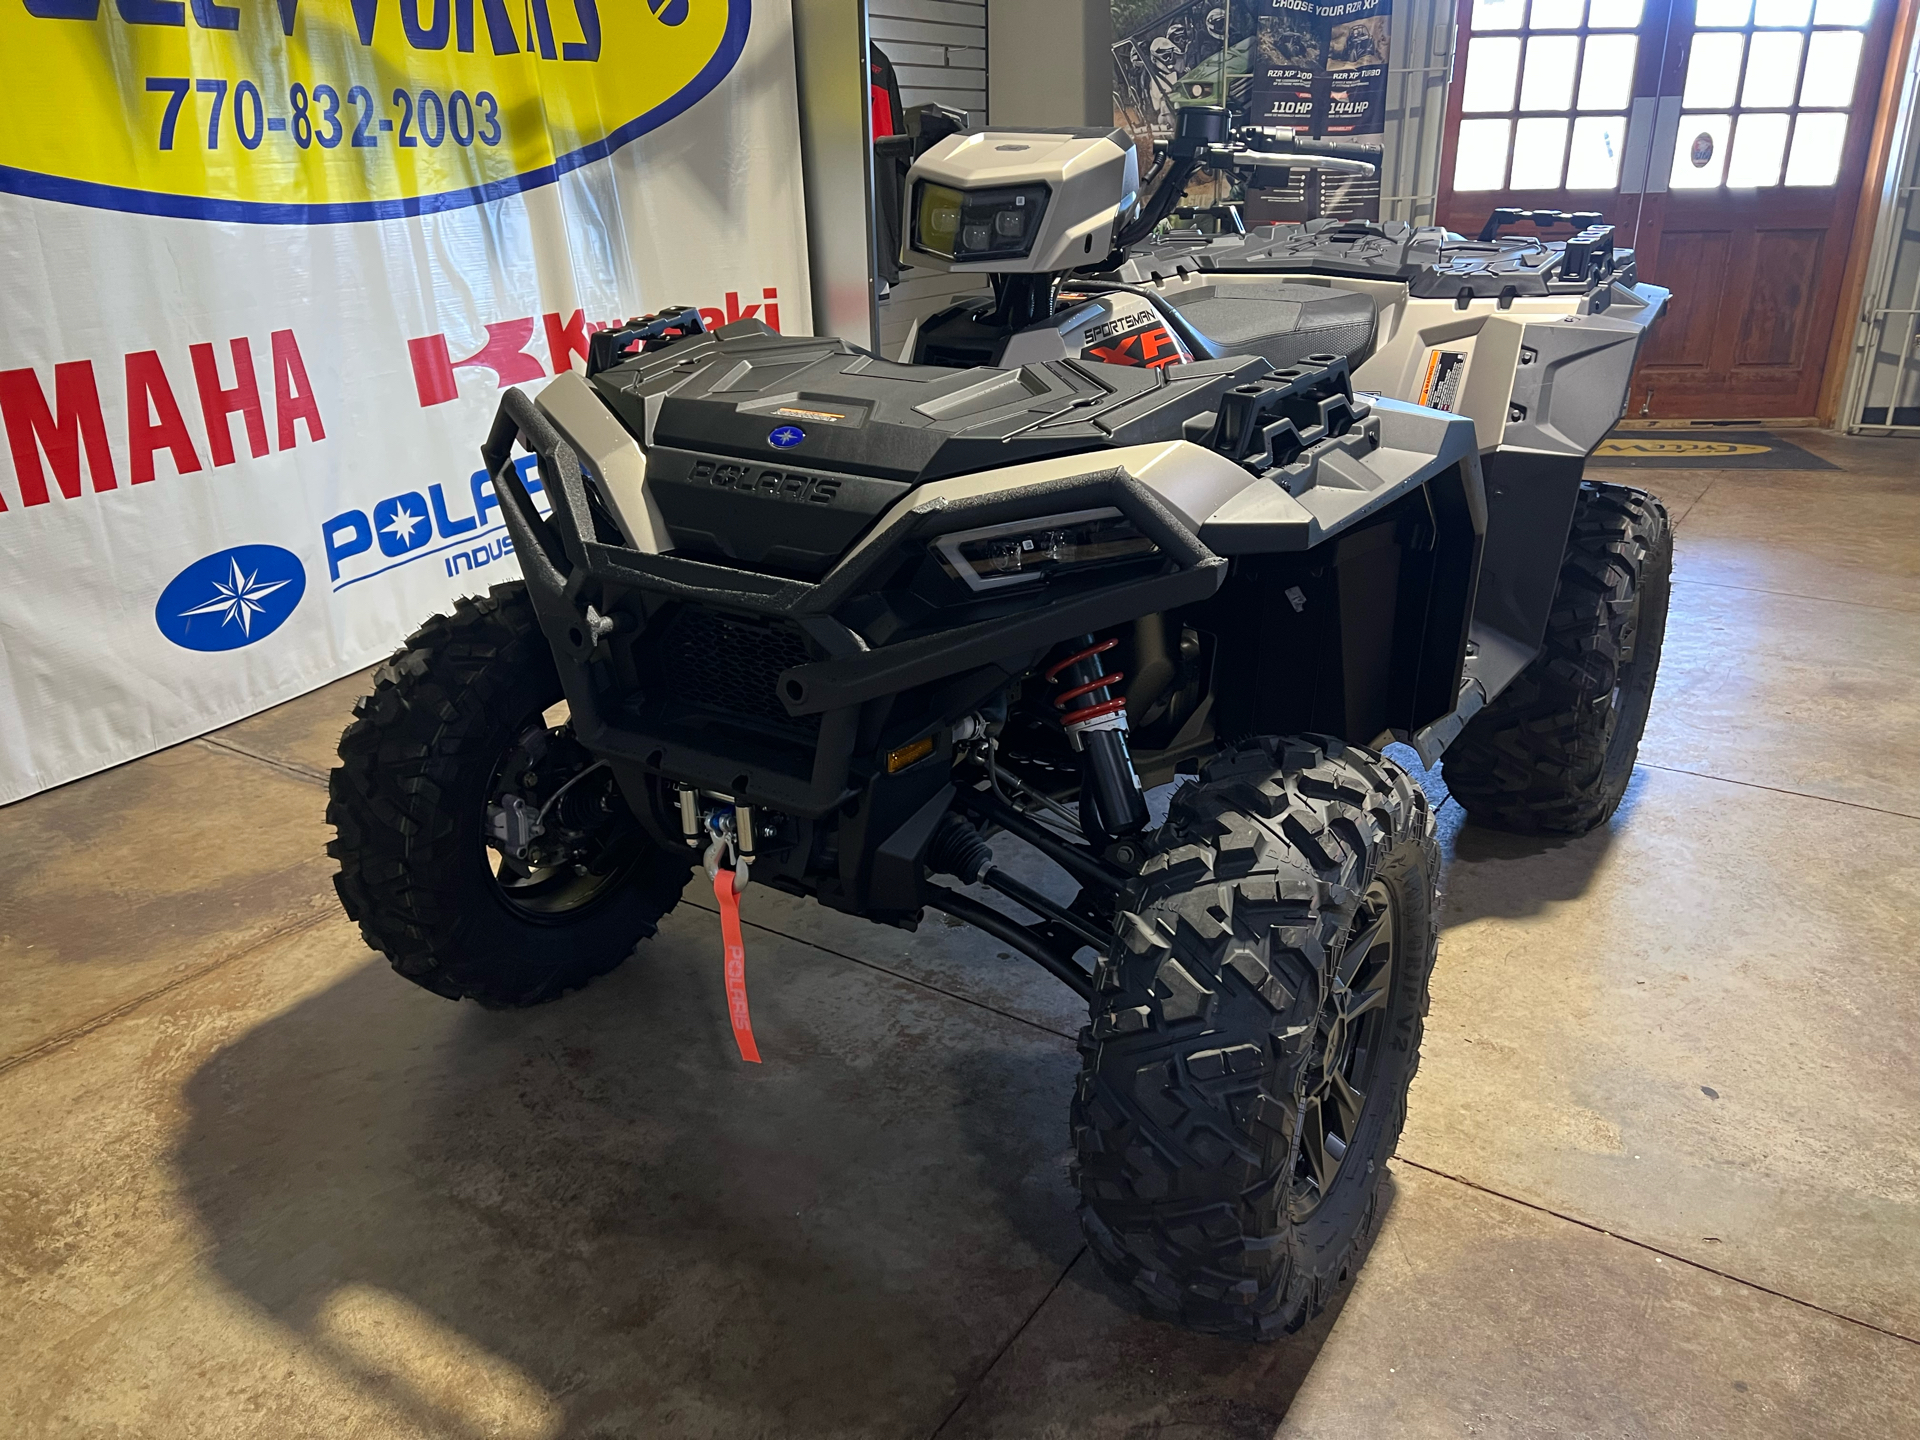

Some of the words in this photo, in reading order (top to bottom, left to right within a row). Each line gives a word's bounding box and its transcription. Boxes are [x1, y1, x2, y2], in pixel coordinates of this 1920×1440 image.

[1272, 0, 1314, 13] CHOOSE
[1315, 5, 1344, 17] YOUR
[1345, 2, 1362, 14] RZR
[145, 77, 502, 151] 770-832-2003
[1271, 102, 1295, 113] 110
[1295, 102, 1312, 114] HP
[1328, 102, 1354, 114] 144
[1354, 101, 1369, 113] HP
[1084, 309, 1156, 344] SPORTSMAN
[0, 328, 326, 513] MAHA
[687, 460, 842, 505] POLARIS
[728, 945, 751, 1032] POLARIS
